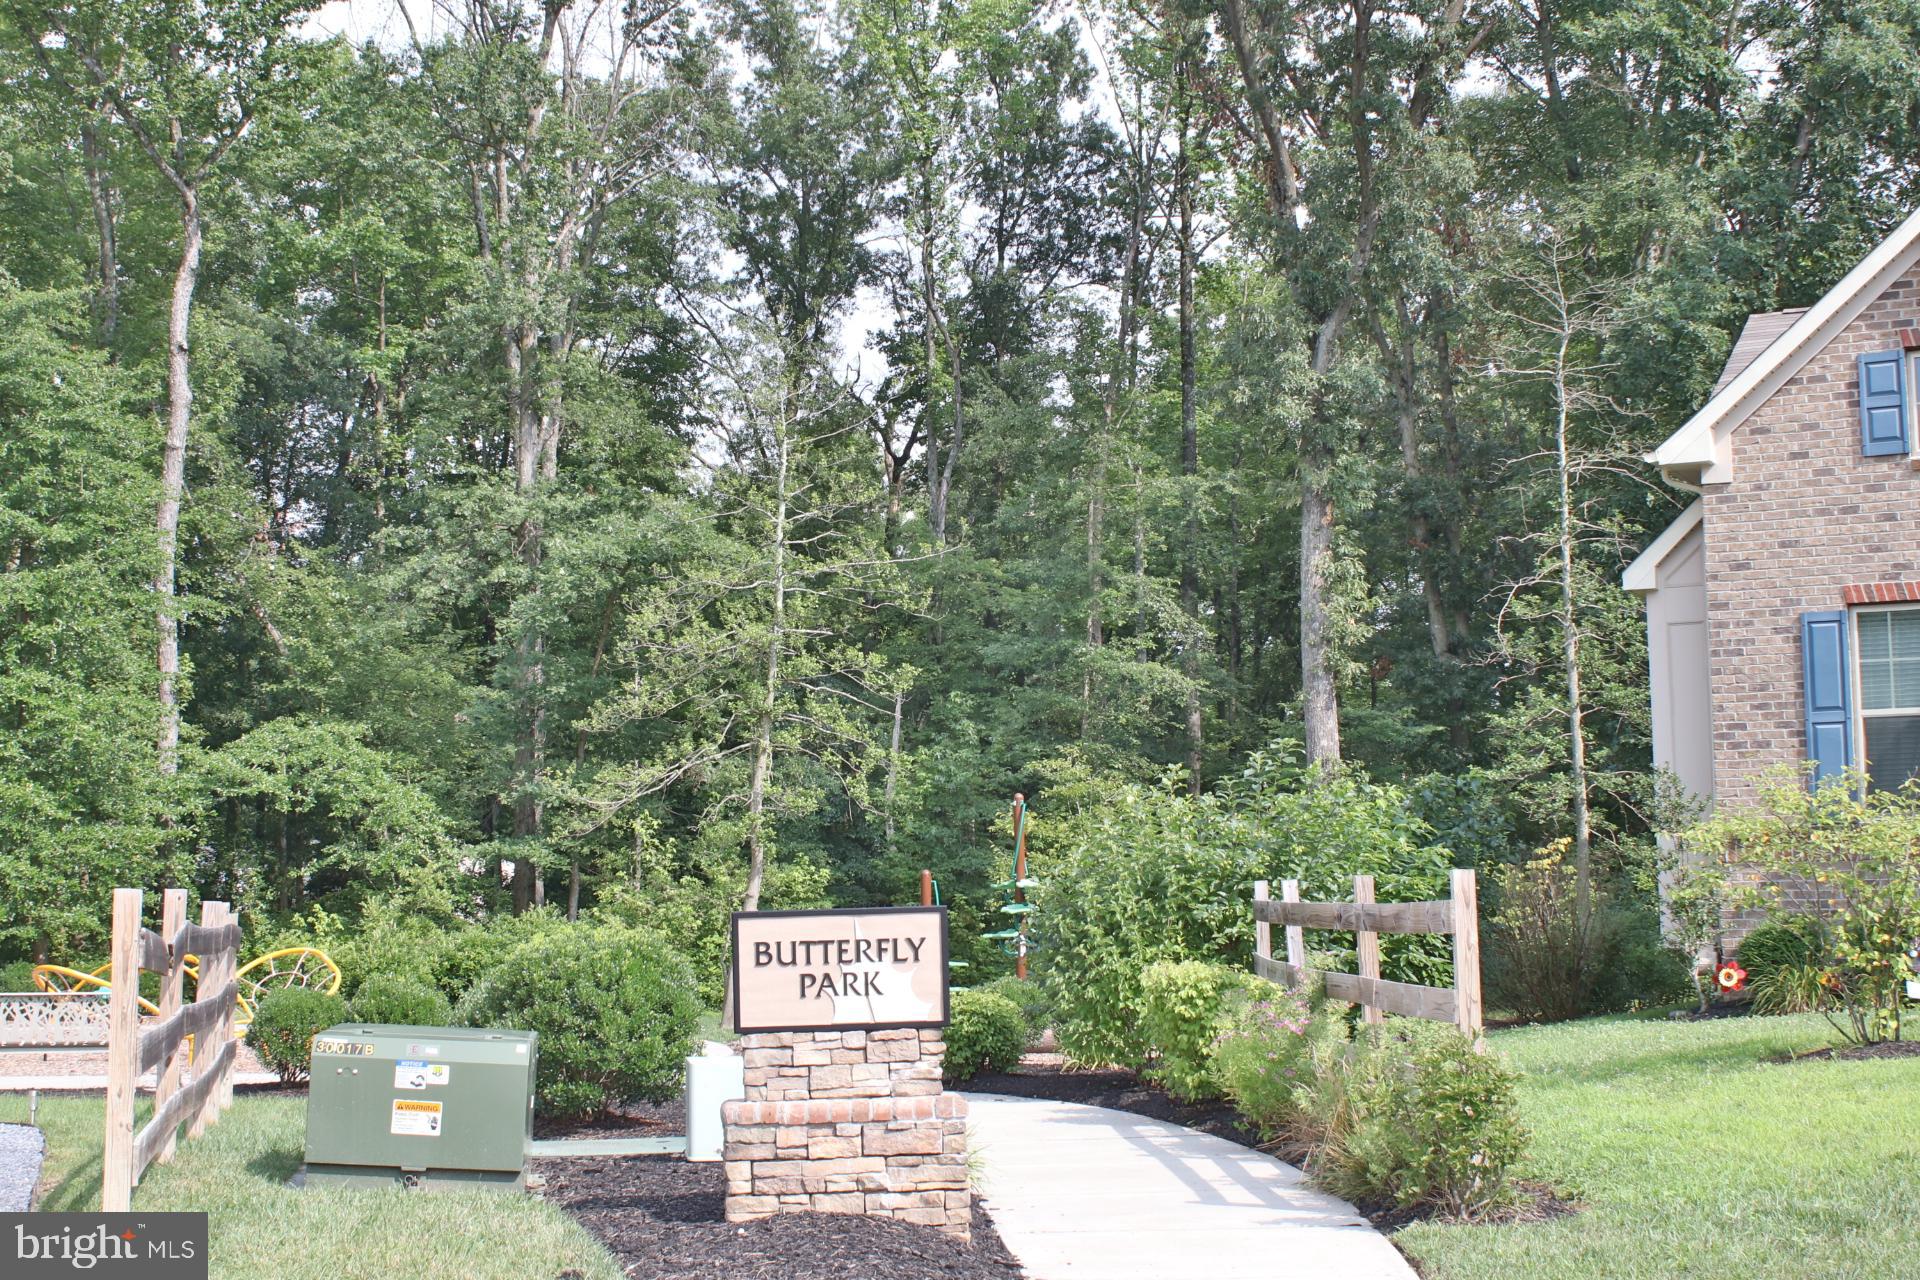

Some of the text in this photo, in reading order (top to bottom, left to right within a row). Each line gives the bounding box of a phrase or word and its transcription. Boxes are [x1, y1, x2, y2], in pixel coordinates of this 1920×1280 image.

[753, 937, 927, 967] BUTTERFLY
[799, 971, 884, 999] PARK
[316, 1040, 375, 1056] 30017B
[404, 1103, 439, 1112] WARNING
